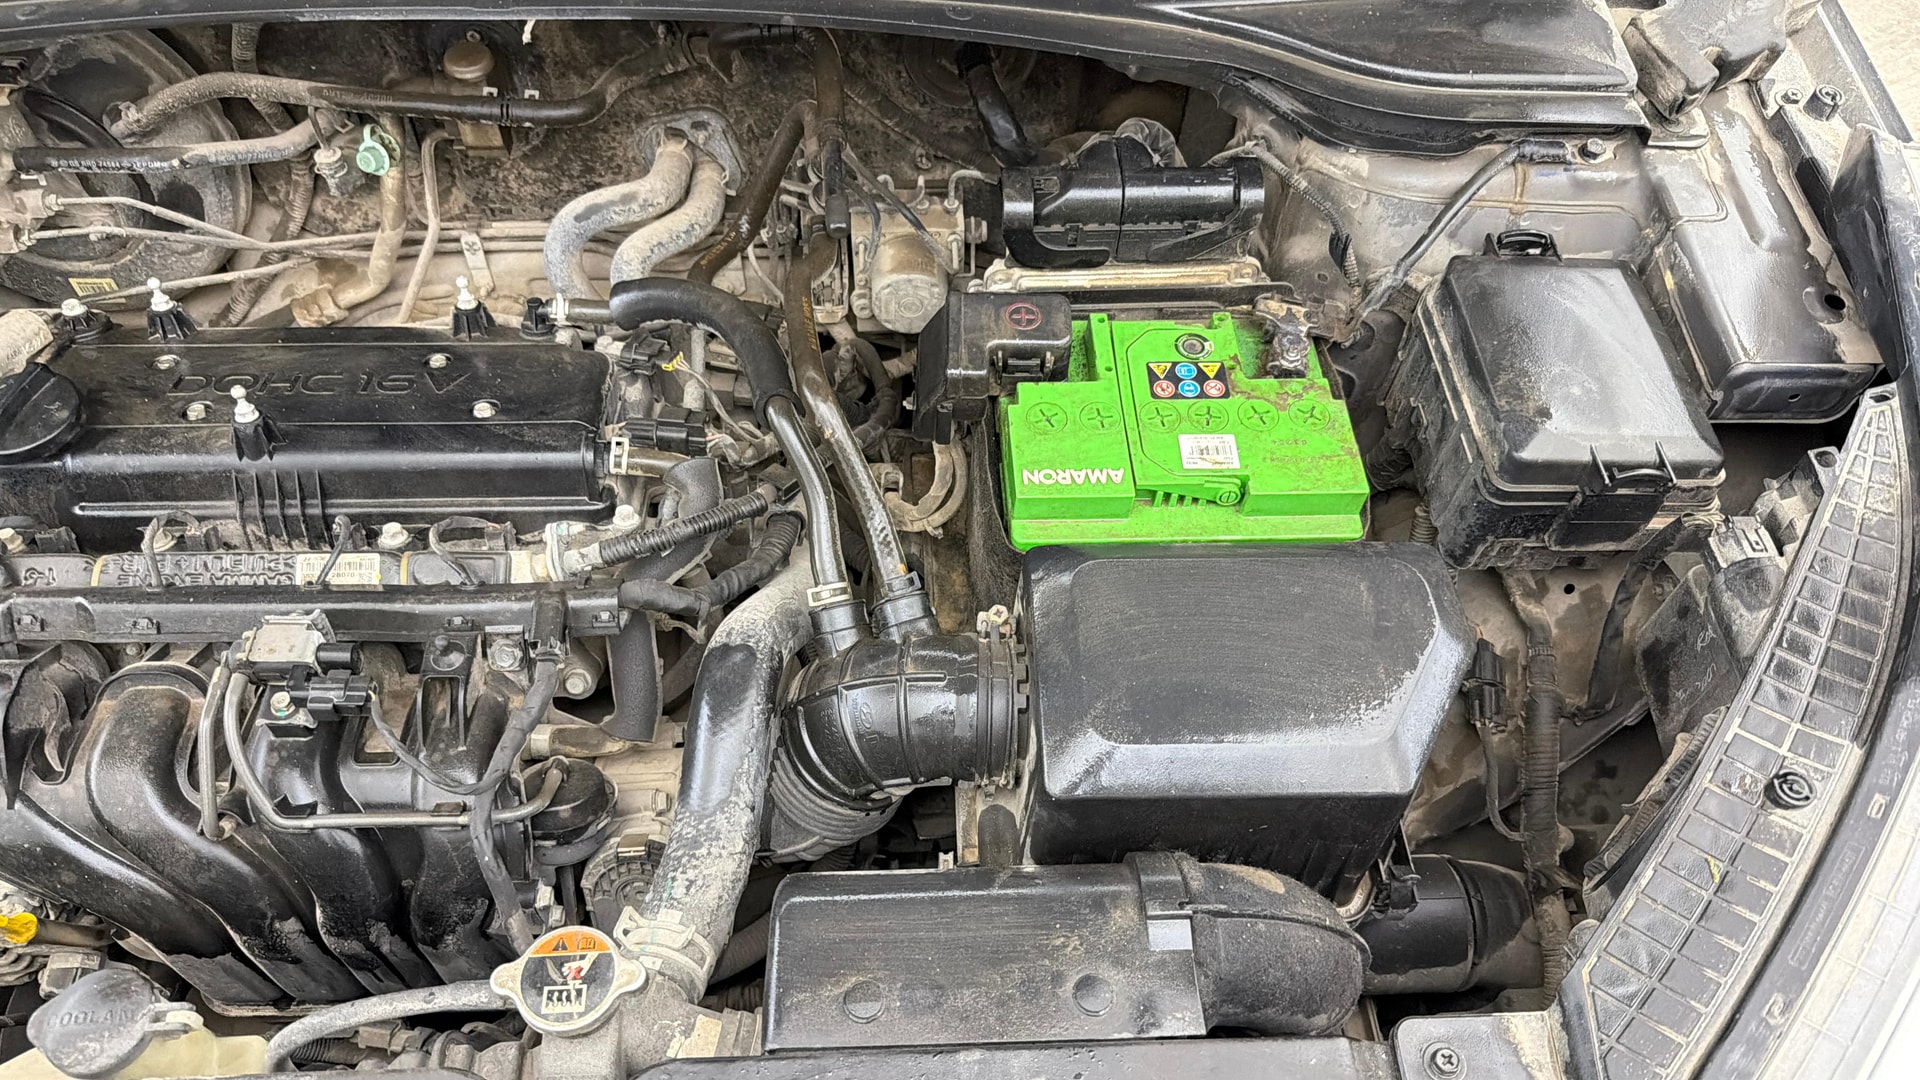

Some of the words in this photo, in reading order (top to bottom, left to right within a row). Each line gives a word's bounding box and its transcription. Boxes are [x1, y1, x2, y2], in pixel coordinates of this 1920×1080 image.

[166, 374, 344, 396] DOHC
[1022, 467, 1125, 486] AMARON
[118, 573, 205, 586] ENGNE
[47, 1007, 140, 1027] COOLAN
